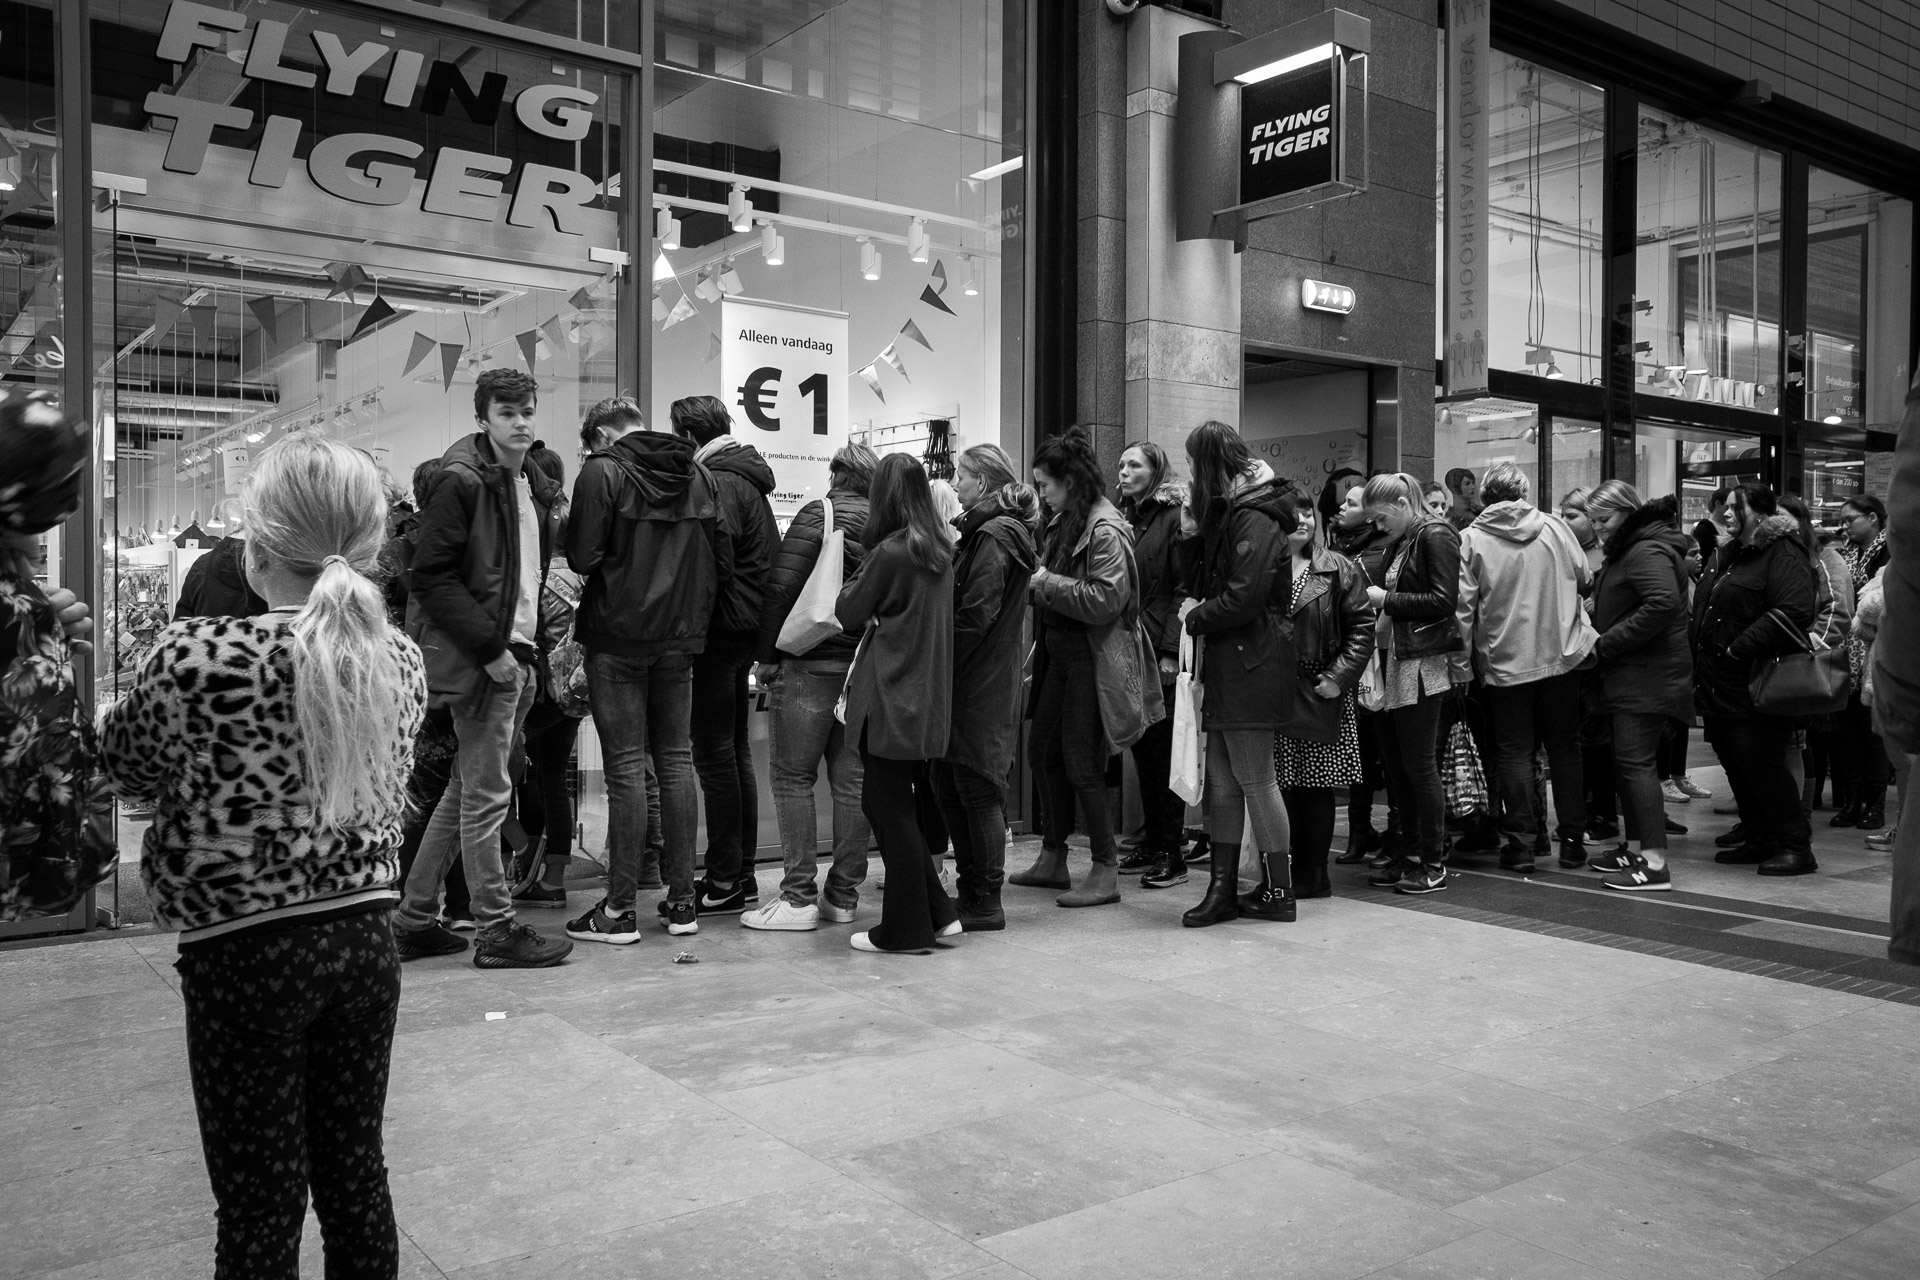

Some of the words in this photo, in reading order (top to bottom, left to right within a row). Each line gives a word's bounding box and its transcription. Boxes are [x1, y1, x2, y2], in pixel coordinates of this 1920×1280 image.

[155, 0, 599, 141] FLYING
[1251, 104, 1331, 142] FLYING
[1249, 126, 1330, 165] TIGER
[143, 91, 597, 236] TIGER
[739, 329, 778, 345] Alleen
[781, 337, 833, 355] vandaag
[737, 367, 782, 431] €
[798, 373, 828, 435] 1
[768, 453, 800, 462] producten
[807, 454, 816, 462] de
[787, 492, 804, 501] tiger
[1615, 855, 1631, 868] N
[1631, 870, 1649, 885] N
